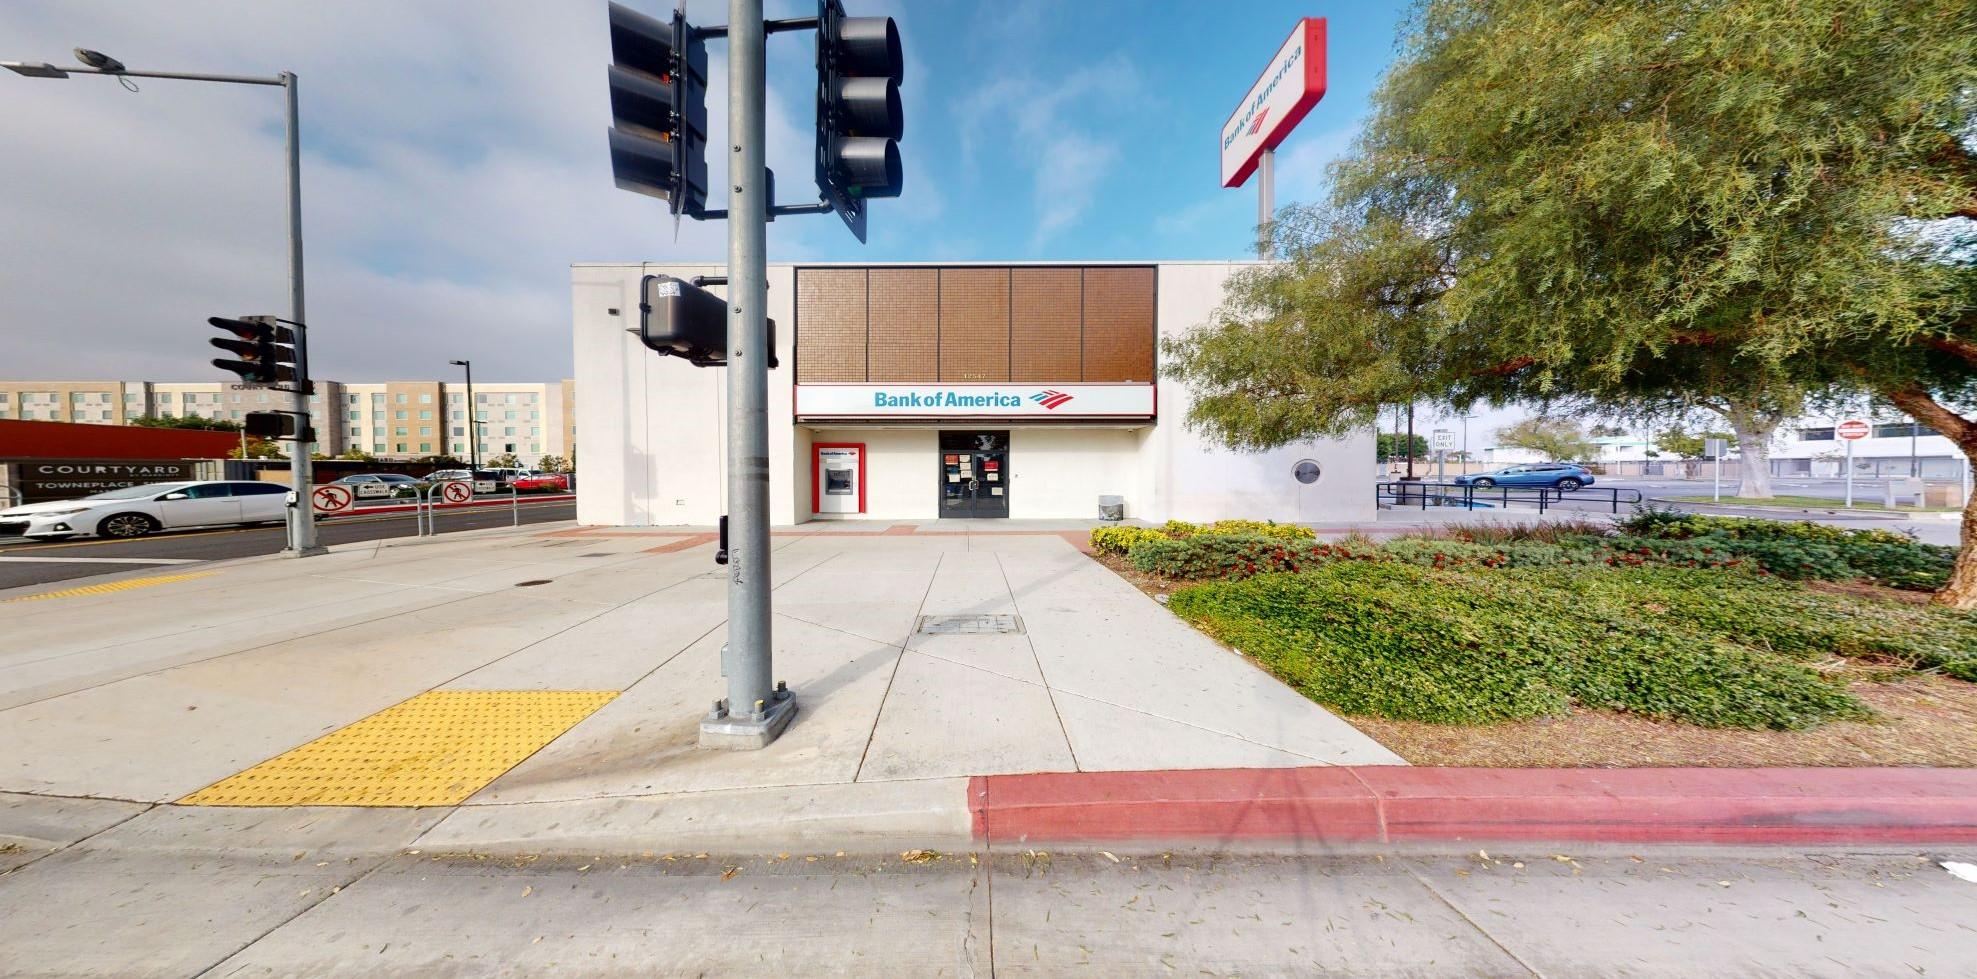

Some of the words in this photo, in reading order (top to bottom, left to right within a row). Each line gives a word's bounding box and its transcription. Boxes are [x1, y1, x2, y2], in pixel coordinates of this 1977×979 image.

[1224, 117, 1245, 149] Bank
[1245, 101, 1255, 122] of
[1256, 45, 1302, 110] America
[875, 392, 921, 407] Bank
[923, 392, 942, 407] of
[944, 392, 1021, 407] America
[38, 465, 180, 474] COURTYARD
[36, 481, 134, 489] TOWNEPLACE
